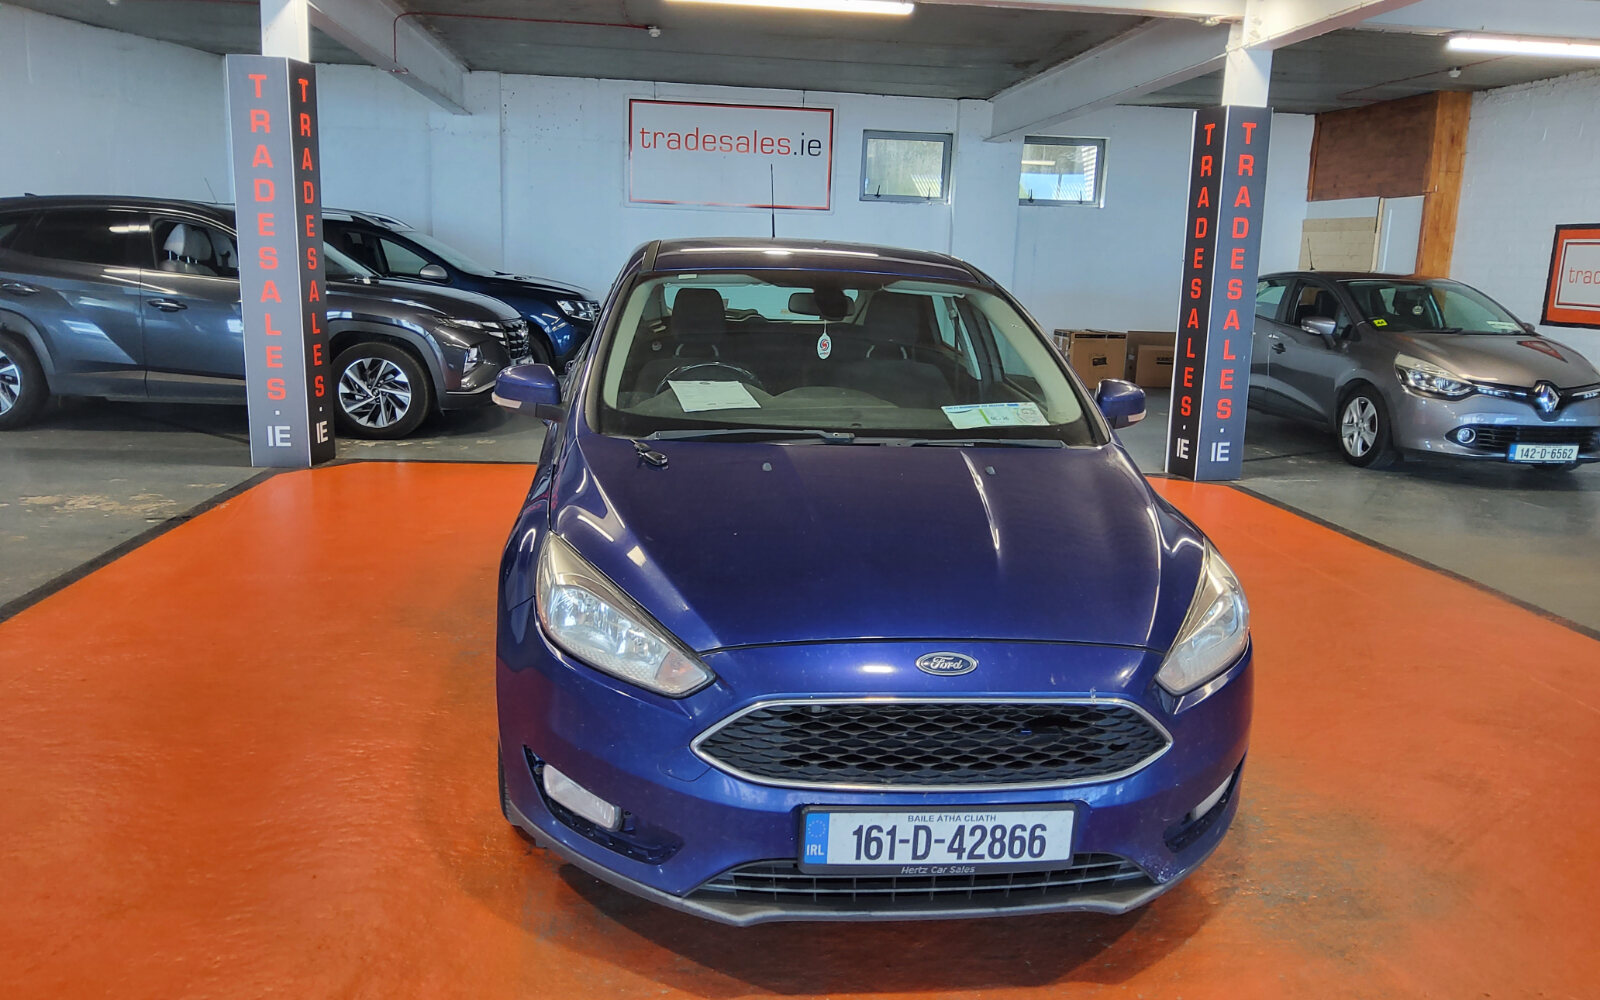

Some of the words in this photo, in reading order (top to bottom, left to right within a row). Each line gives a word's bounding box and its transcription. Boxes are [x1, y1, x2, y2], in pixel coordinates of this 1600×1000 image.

[639, 126, 822, 157] tradesales.ie
[1520, 447, 1574, 459] 142-D-6562
[930, 656, 963, 670] Ford
[907, 814, 935, 823] BAILE
[963, 813, 997, 822] CLIATH
[851, 823, 1048, 861] 161-D-42866
[806, 844, 825, 857] IRL
[900, 866, 929, 875] Hertz
[930, 866, 948, 874] Car
[949, 865, 976, 874] Sales
